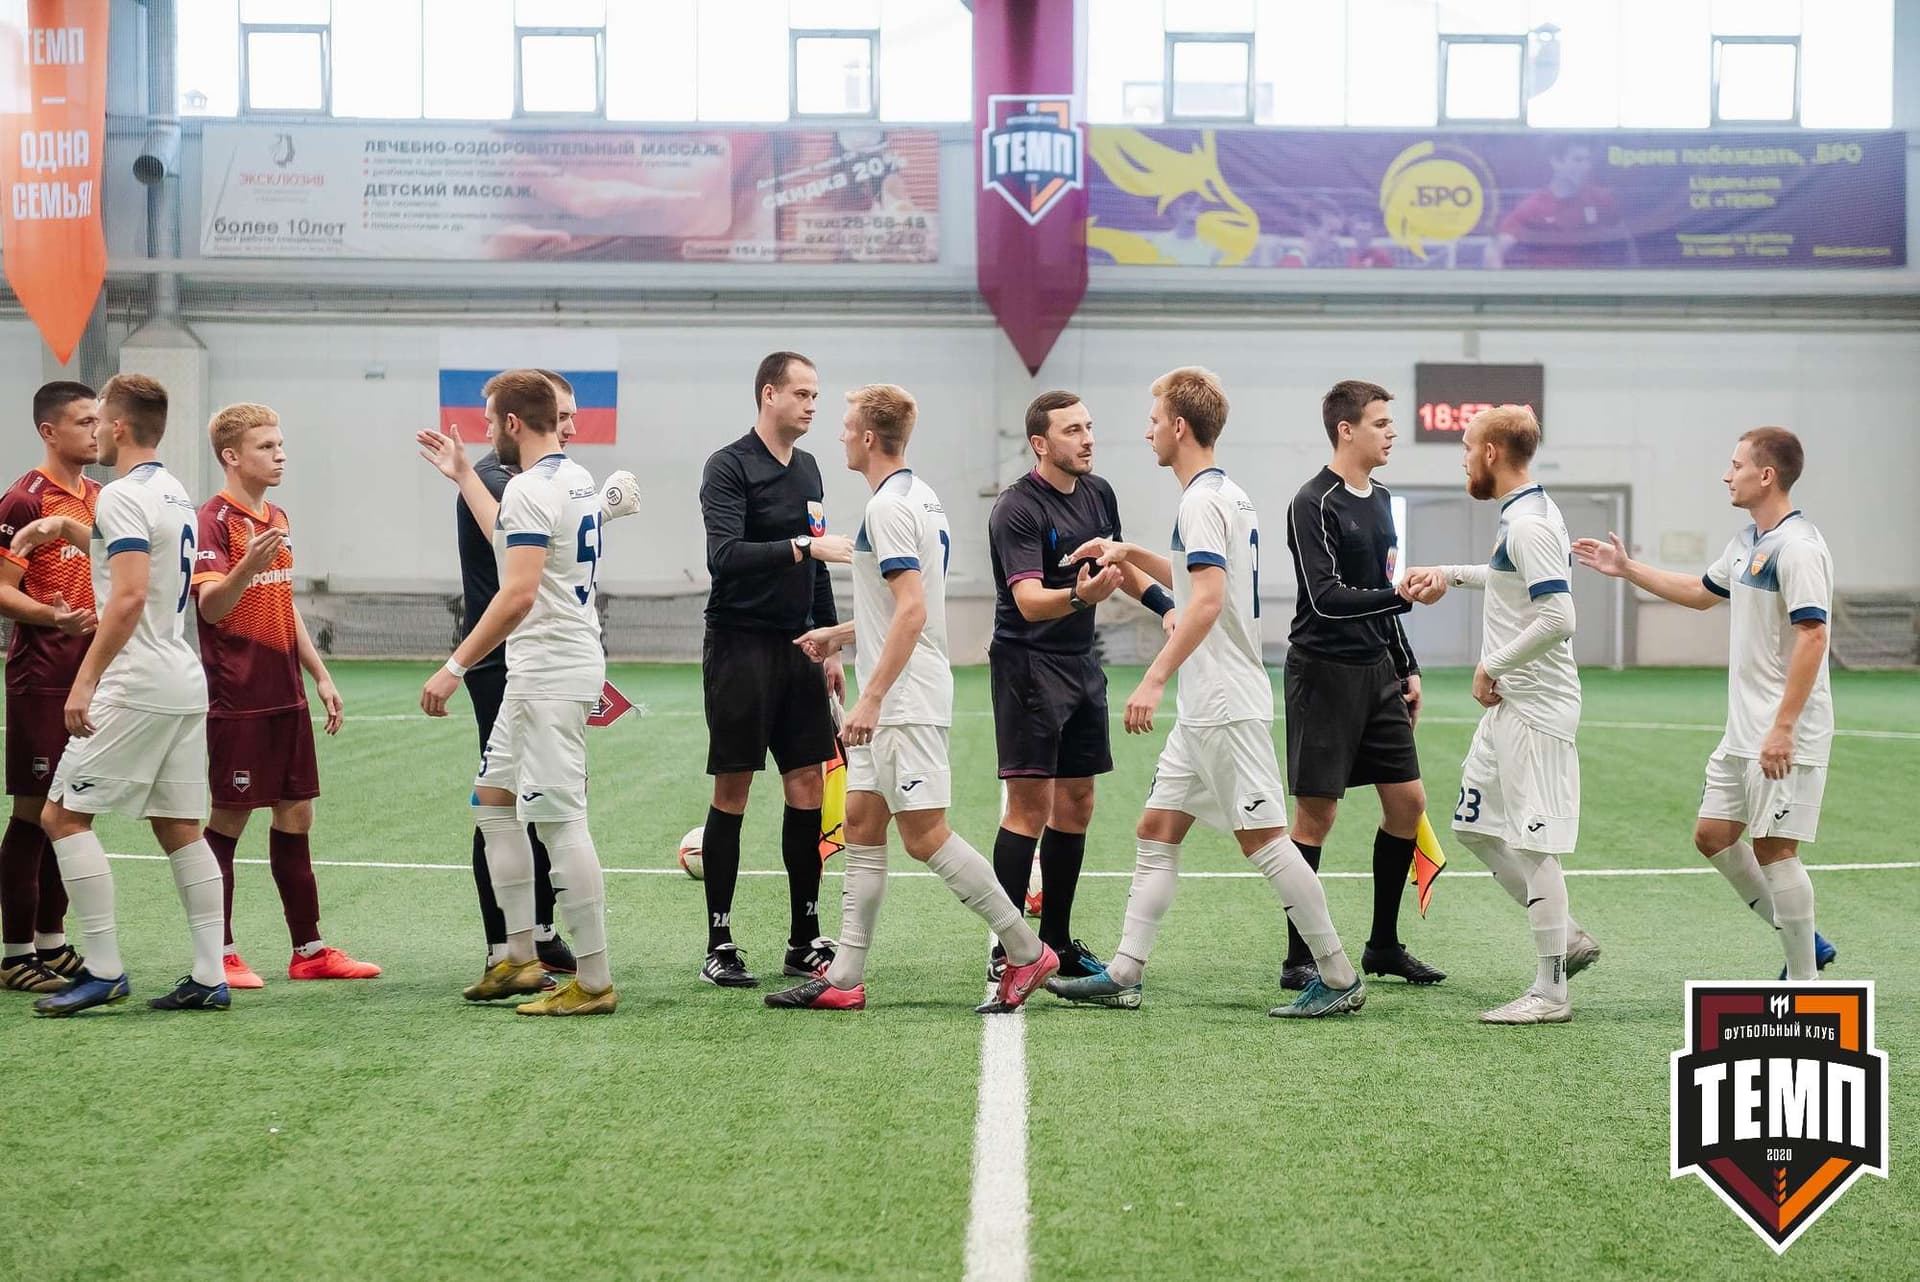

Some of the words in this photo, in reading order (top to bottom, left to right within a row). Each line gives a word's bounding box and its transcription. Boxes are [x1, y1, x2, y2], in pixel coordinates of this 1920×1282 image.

[20, 130, 90, 174] ОДНА
[992, 130, 1073, 175] ТЕМП
[364, 182, 447, 198] ДЕТСКИЙ
[214, 216, 279, 235] более
[1454, 786, 1482, 823] 23
